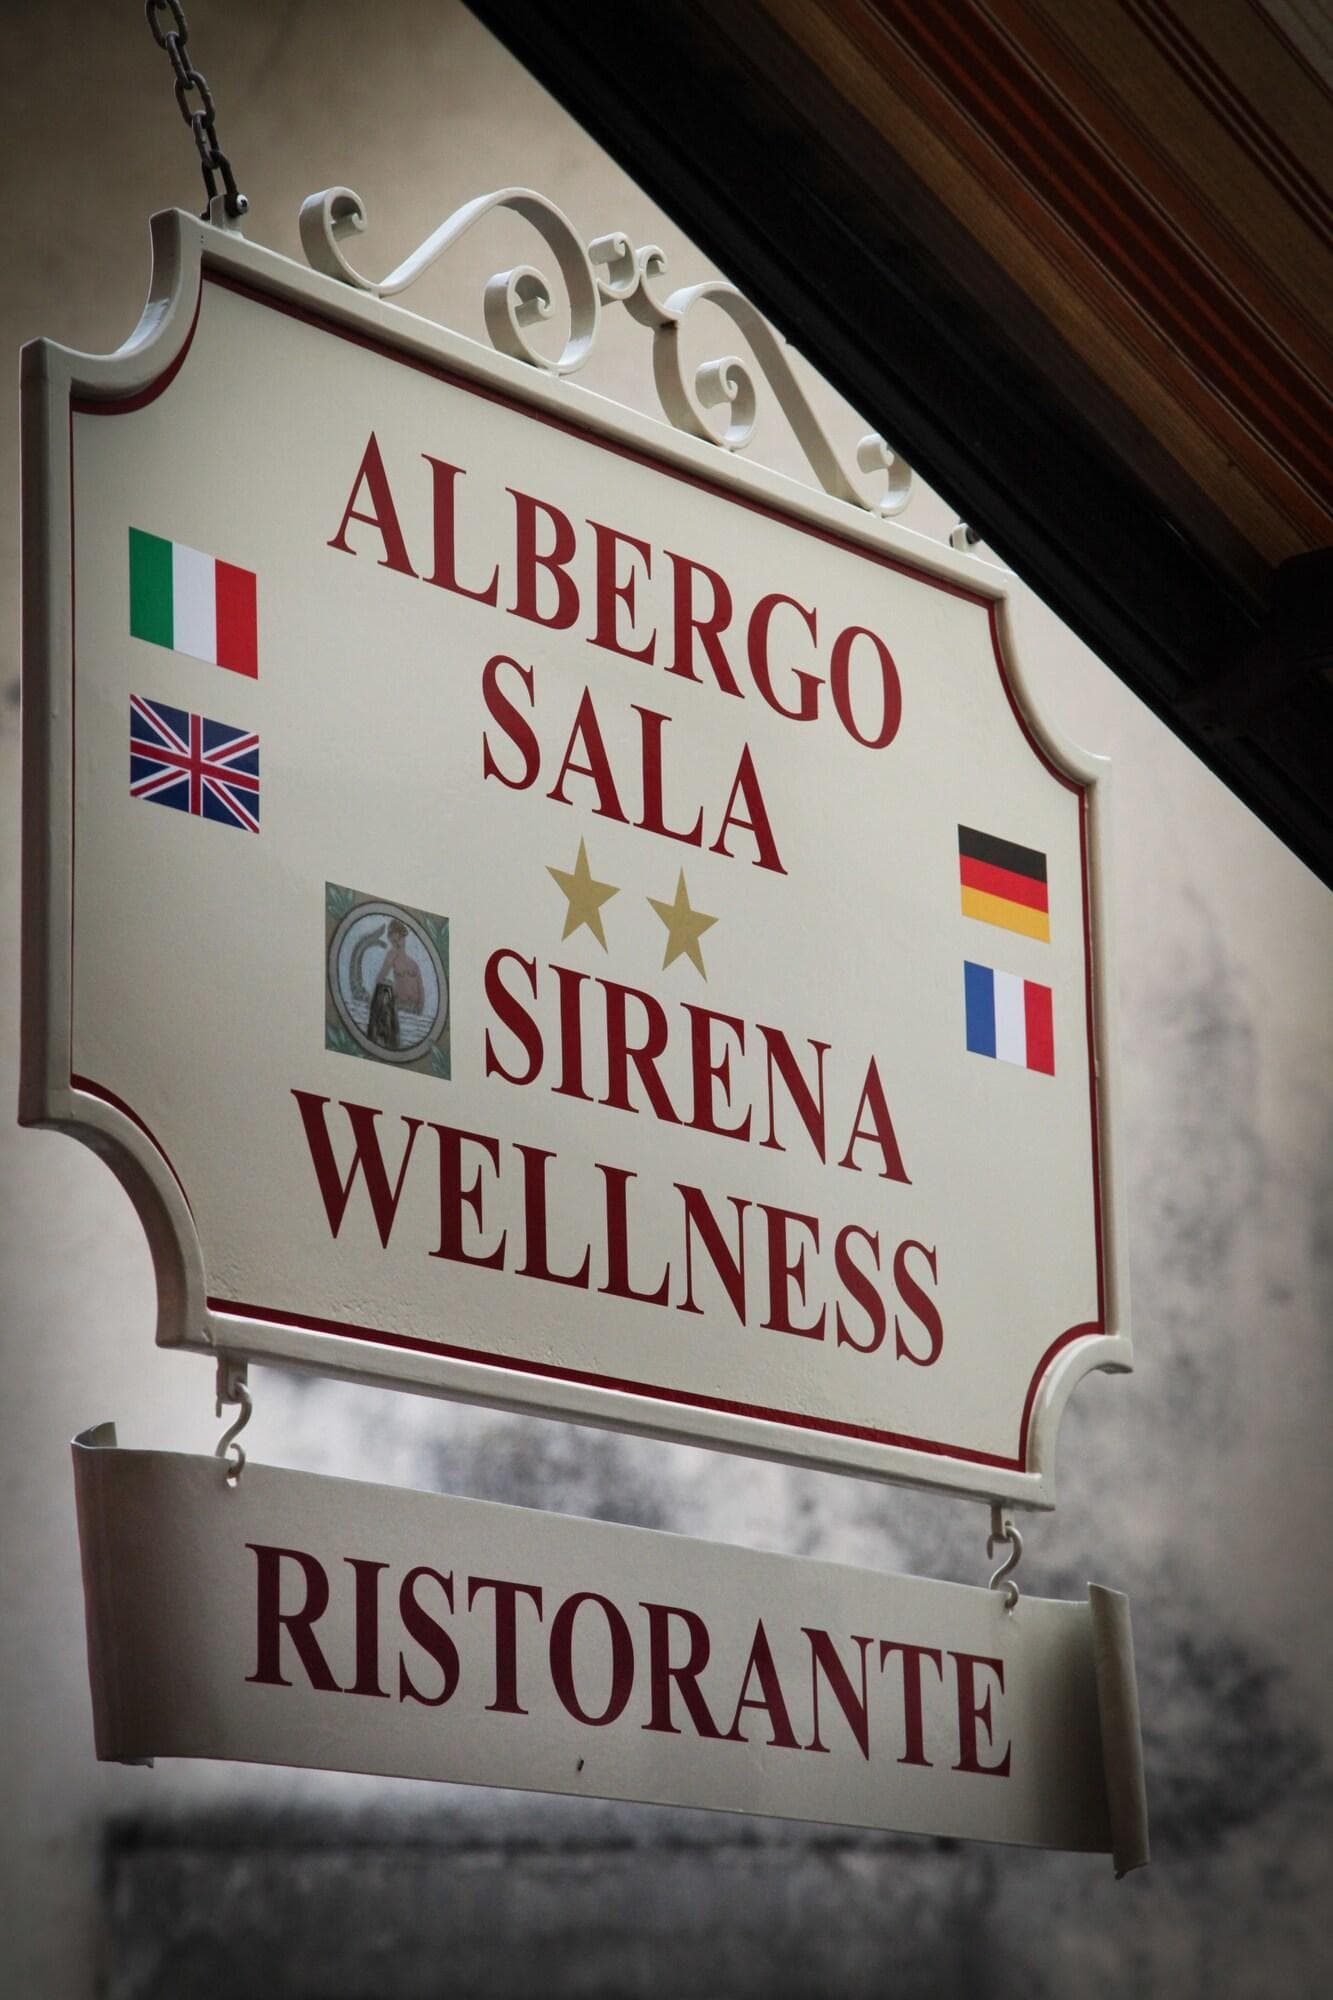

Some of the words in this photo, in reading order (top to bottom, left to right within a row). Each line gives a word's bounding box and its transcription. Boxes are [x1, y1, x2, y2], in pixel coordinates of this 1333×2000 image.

[327, 431, 903, 750] ALBERGO
[482, 654, 788, 875] SALA
[484, 948, 913, 1185] SIRENA
[290, 1089, 944, 1367] WELLNESS
[245, 1543, 1012, 1777] RISTORANTE
